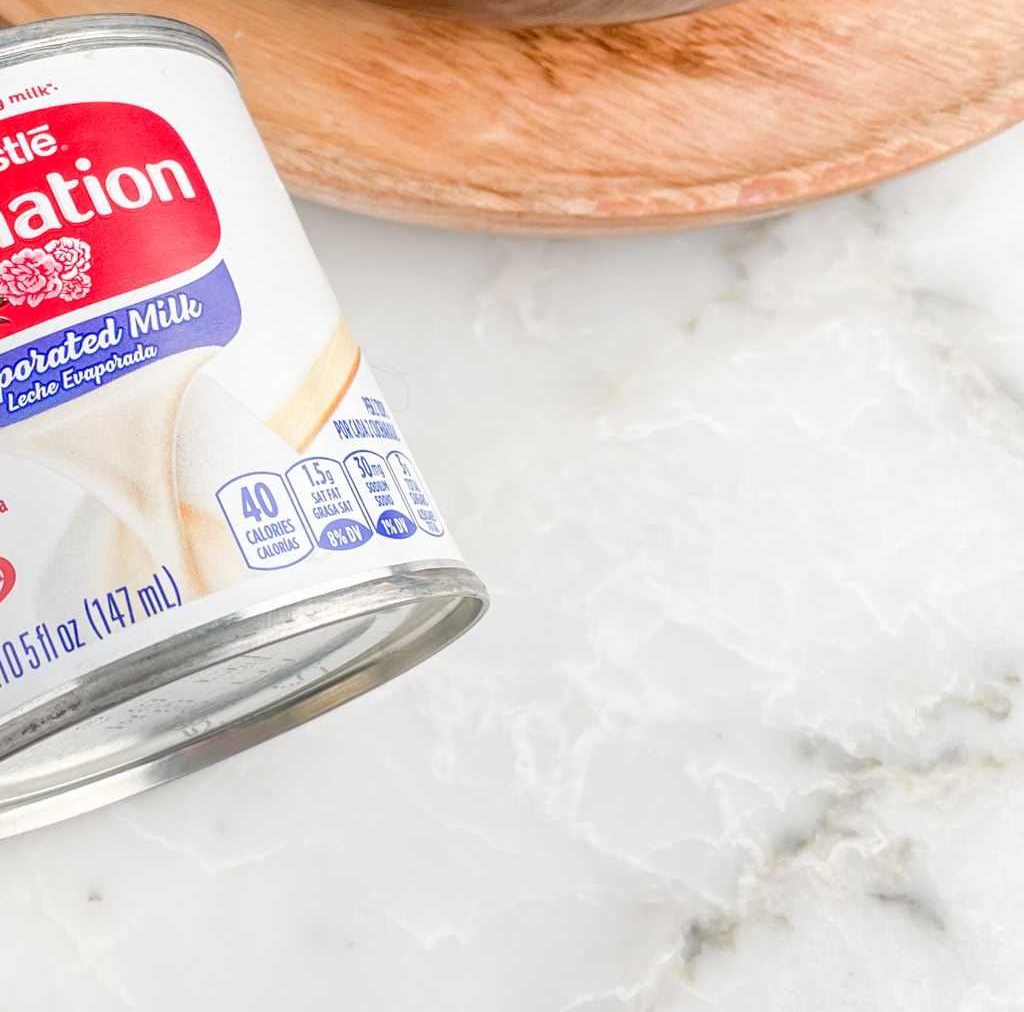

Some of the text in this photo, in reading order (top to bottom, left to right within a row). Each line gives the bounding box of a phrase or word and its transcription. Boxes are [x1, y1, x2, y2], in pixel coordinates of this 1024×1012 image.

[128, 293, 203, 339] Milk
[7, 343, 158, 413] Leche Evaporada
[333, 419, 352, 441] POR
[301, 461, 335, 487] 1.5g
[311, 487, 342, 504] SAT FAT
[365, 480, 389, 494] SODIUM
[240, 481, 279, 523] 40
[312, 500, 354, 521] GRASA SAT
[245, 519, 296, 545] CALORIES
[326, 525, 363, 549] 8% DV
[381, 517, 408, 536] 1% DV
[256, 537, 301, 561] CALORÍAS
[19, 631, 41, 670] 5
[36, 622, 59, 663] fl
[56, 618, 86, 653] oz
[84, 585, 136, 640] (147
[137, 565, 182, 618] mL)
